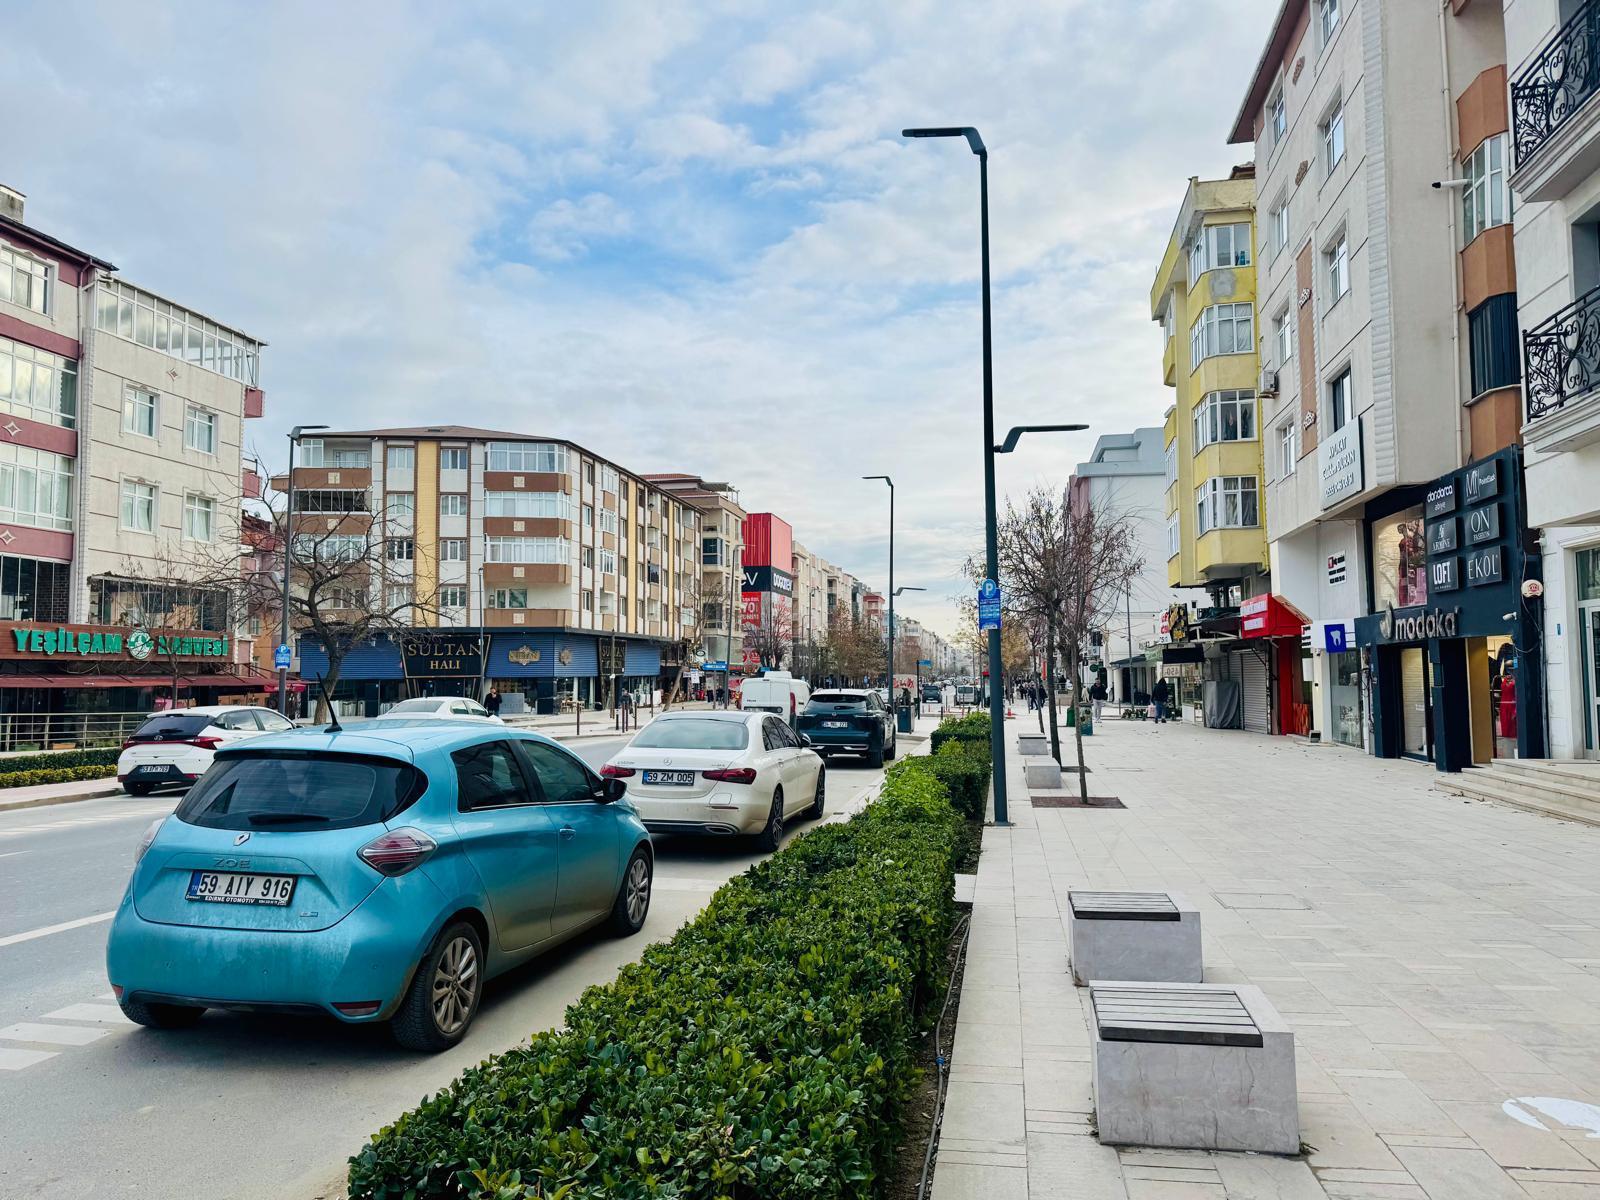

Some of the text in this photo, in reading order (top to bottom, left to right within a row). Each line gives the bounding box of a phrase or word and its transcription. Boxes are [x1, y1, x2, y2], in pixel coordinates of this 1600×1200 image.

[1470, 507, 1490, 533] ON
[1432, 561, 1451, 586] LOFT
[1468, 554, 1499, 580] EKOL
[985, 582, 994, 596] P
[1394, 607, 1456, 641] modaka
[12, 627, 122, 656] YEŞİLÇAM
[407, 643, 482, 657] SULTAN
[430, 660, 461, 670] HALI
[647, 772, 693, 783] 59 ZM 005
[215, 859, 251, 869] ZOE
[199, 875, 219, 894] 59
[224, 876, 255, 896] AIY
[261, 879, 291, 899] 916
